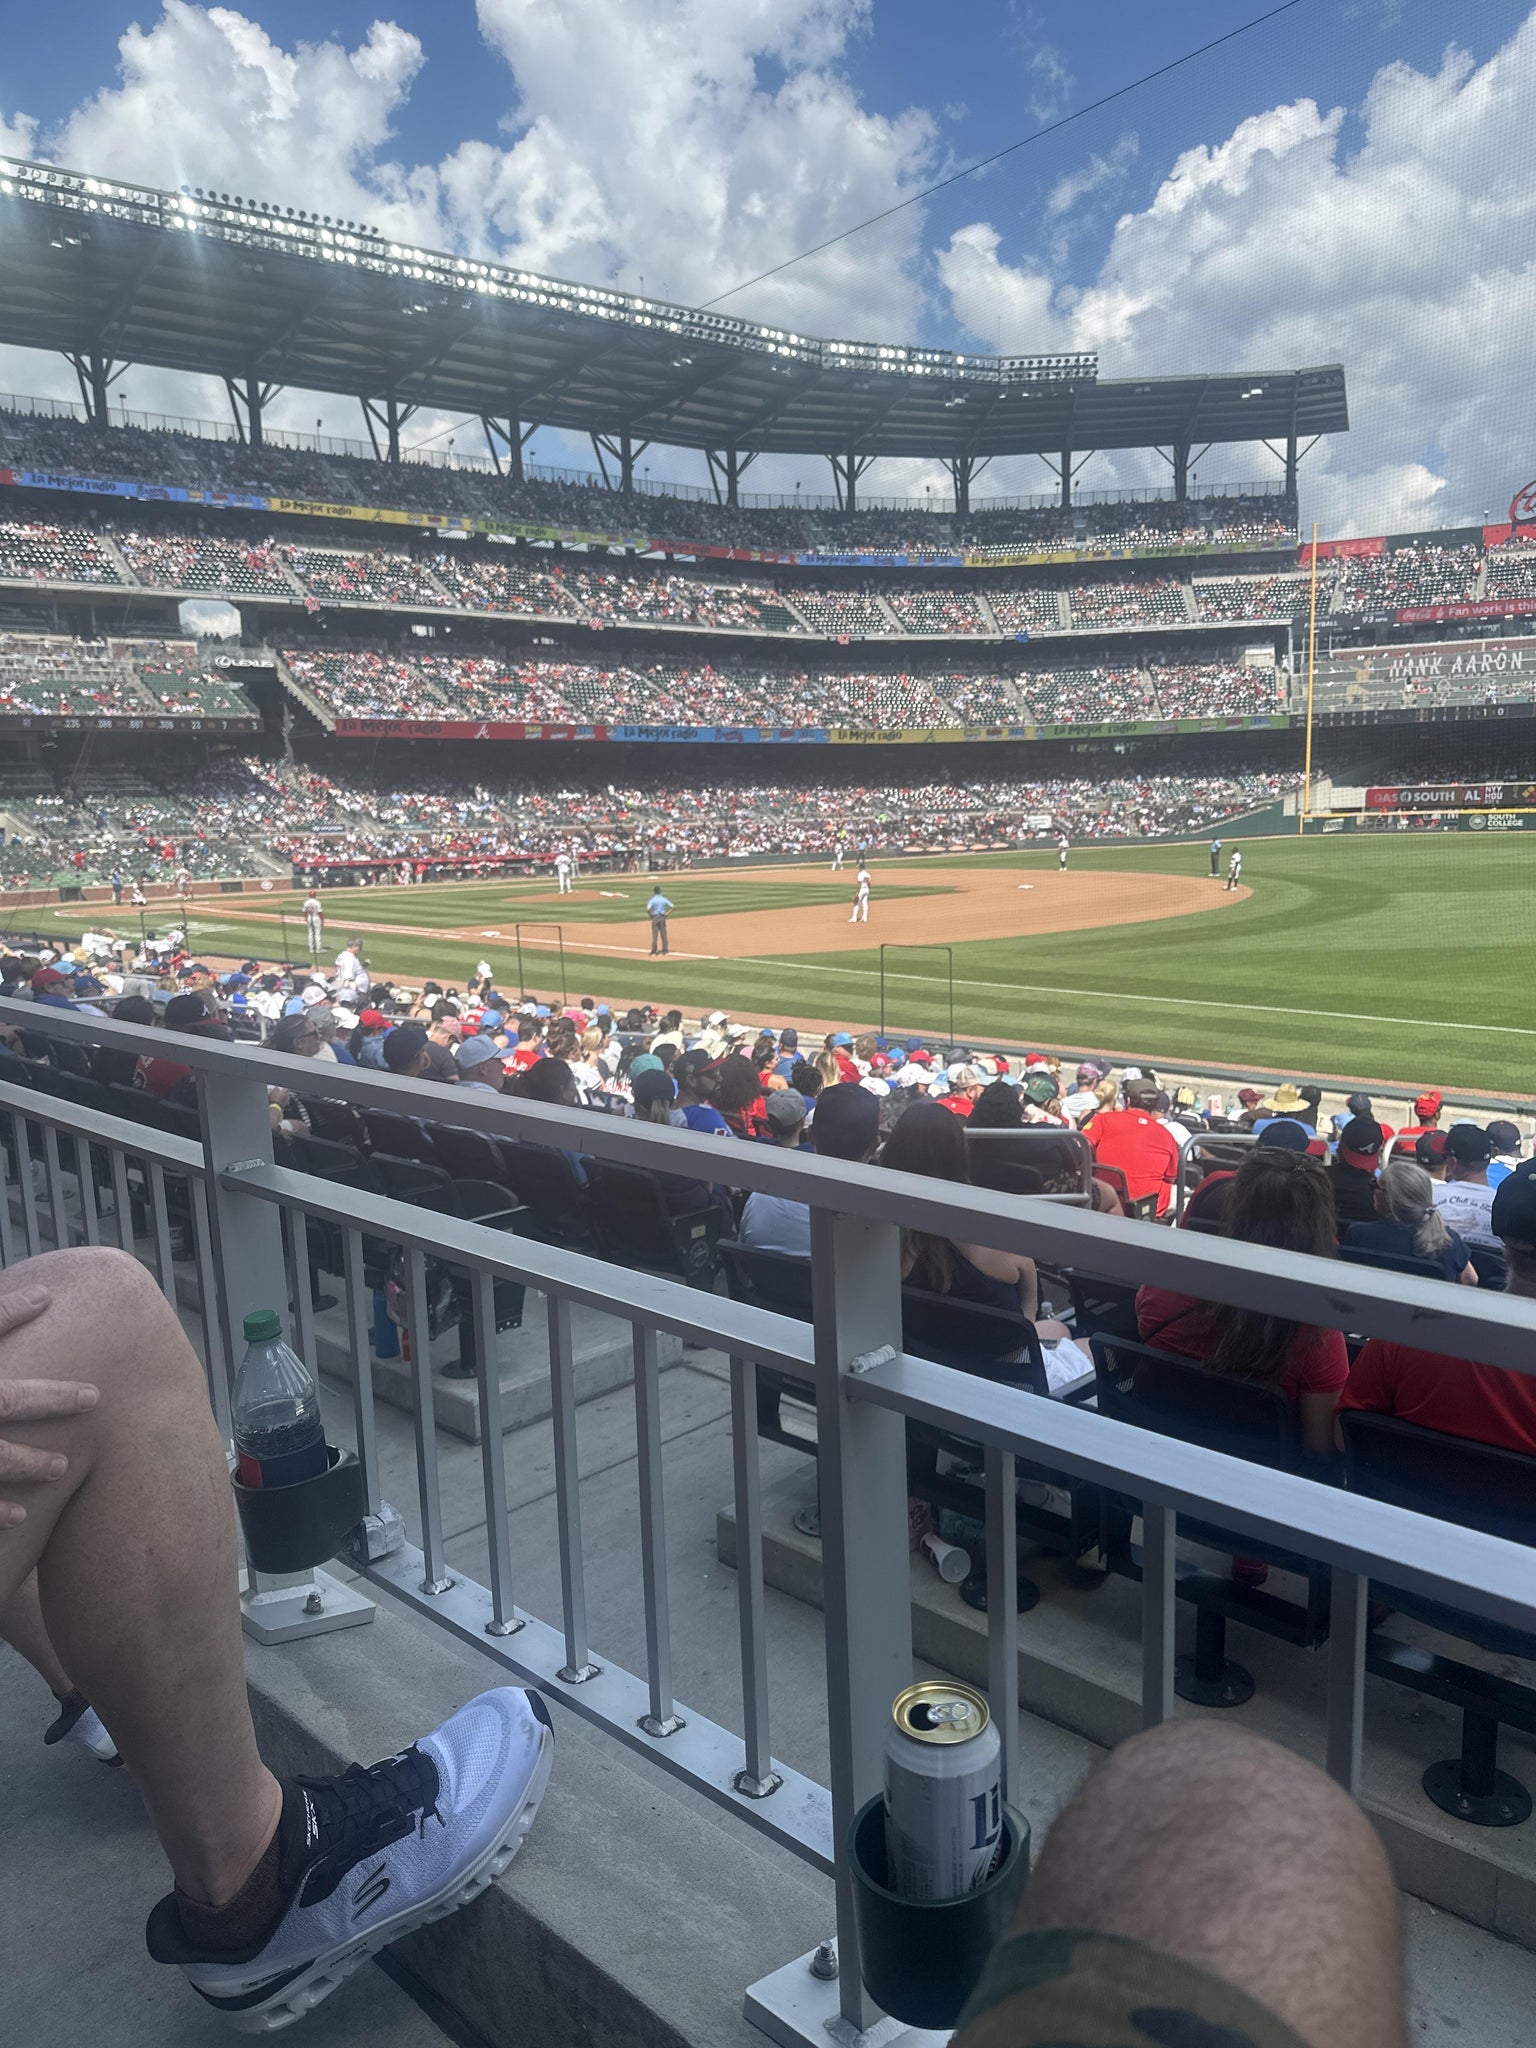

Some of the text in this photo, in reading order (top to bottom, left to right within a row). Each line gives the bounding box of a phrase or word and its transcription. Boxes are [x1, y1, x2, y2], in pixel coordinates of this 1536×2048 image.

[1449, 607, 1469, 616] Fan
[1472, 604, 1502, 614] work
[1505, 602, 1515, 612] is
[231, 659, 275, 668] LEXUS
[1389, 651, 1523, 678] HANK AARON
[1485, 785, 1502, 793] NYY
[1413, 791, 1455, 802] SOUTH
[1464, 790, 1481, 801] AL
